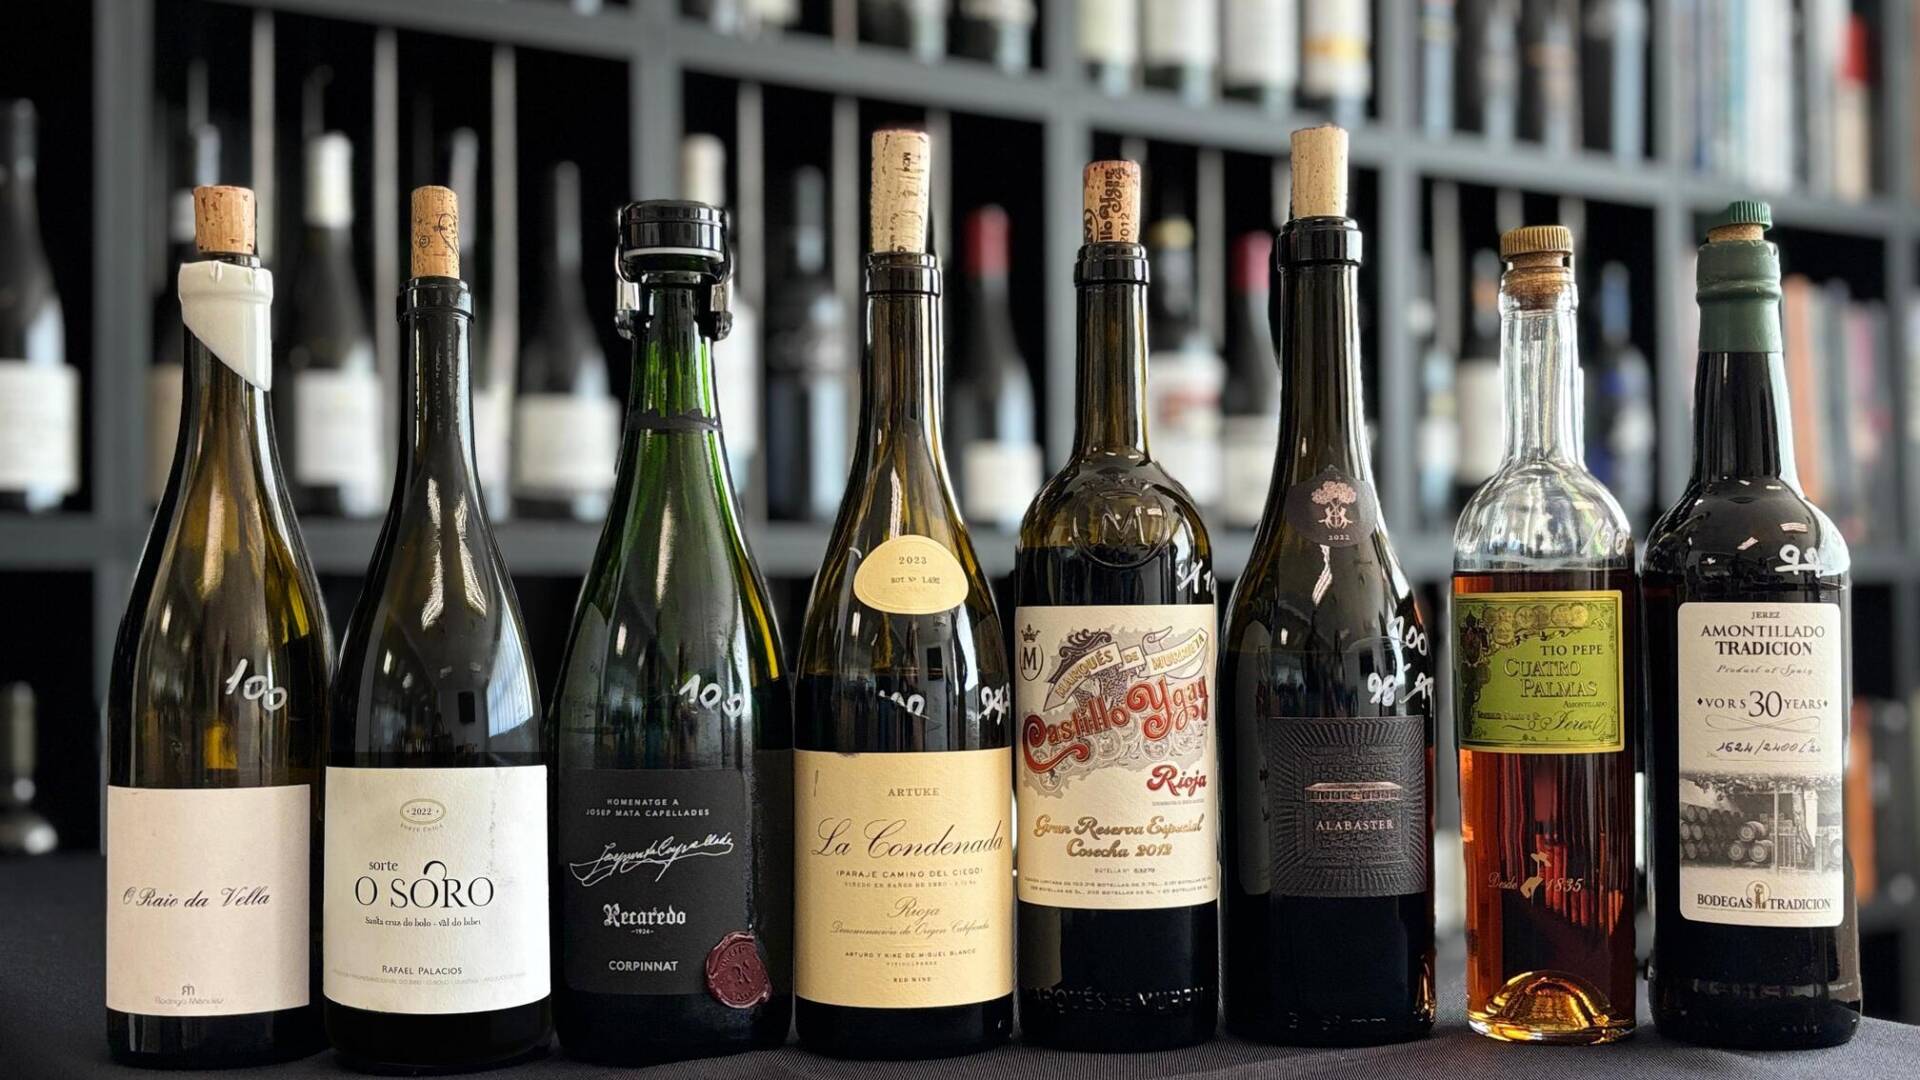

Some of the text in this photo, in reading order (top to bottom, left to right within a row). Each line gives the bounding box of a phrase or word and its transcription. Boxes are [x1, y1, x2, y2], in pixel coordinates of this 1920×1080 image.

[899, 556, 928, 565] 2023
[1751, 611, 1780, 620] JEREZ
[1701, 624, 1825, 638] AMONTILLADO
[1540, 644, 1604, 656] TIO PEPE
[1715, 640, 1813, 656] TRADICION
[1023, 647, 1037, 671] M
[1124, 651, 1139, 663] DE
[1503, 658, 1582, 678] CUATRO
[1716, 663, 1760, 673] Product
[225, 658, 288, 711] 100
[1520, 679, 1598, 698] PALMAS
[1705, 690, 1822, 718] VORS 30 YEARS
[1022, 695, 1131, 774] Castillo
[1126, 675, 1209, 741] Ygay
[1146, 764, 1206, 797] Rioja
[888, 787, 940, 797] ARTUKE
[411, 807, 433, 816] 2022
[586, 808, 710, 817] JOSEP MATA CAPELLADES
[1033, 813, 1205, 840] Gran Reserva Especial
[1315, 819, 1394, 831] ALABASTER
[811, 817, 1004, 859] La Condenada
[1066, 838, 1173, 858] Cosecha 2012
[369, 861, 399, 872] sorte
[882, 870, 925, 879] CAMINO
[929, 869, 948, 878] DEL
[355, 876, 378, 906] O
[1547, 877, 1583, 893] 1835
[123, 886, 271, 908] O Raio da Vella
[1697, 893, 1831, 910] BODEGAS TRADICION
[603, 903, 686, 928] Recaredo
[887, 897, 940, 922] Rioja
[414, 917, 432, 927] bolo
[382, 965, 463, 976] RAFAEL PALACIOS
[608, 961, 679, 972] CORPINNAT
